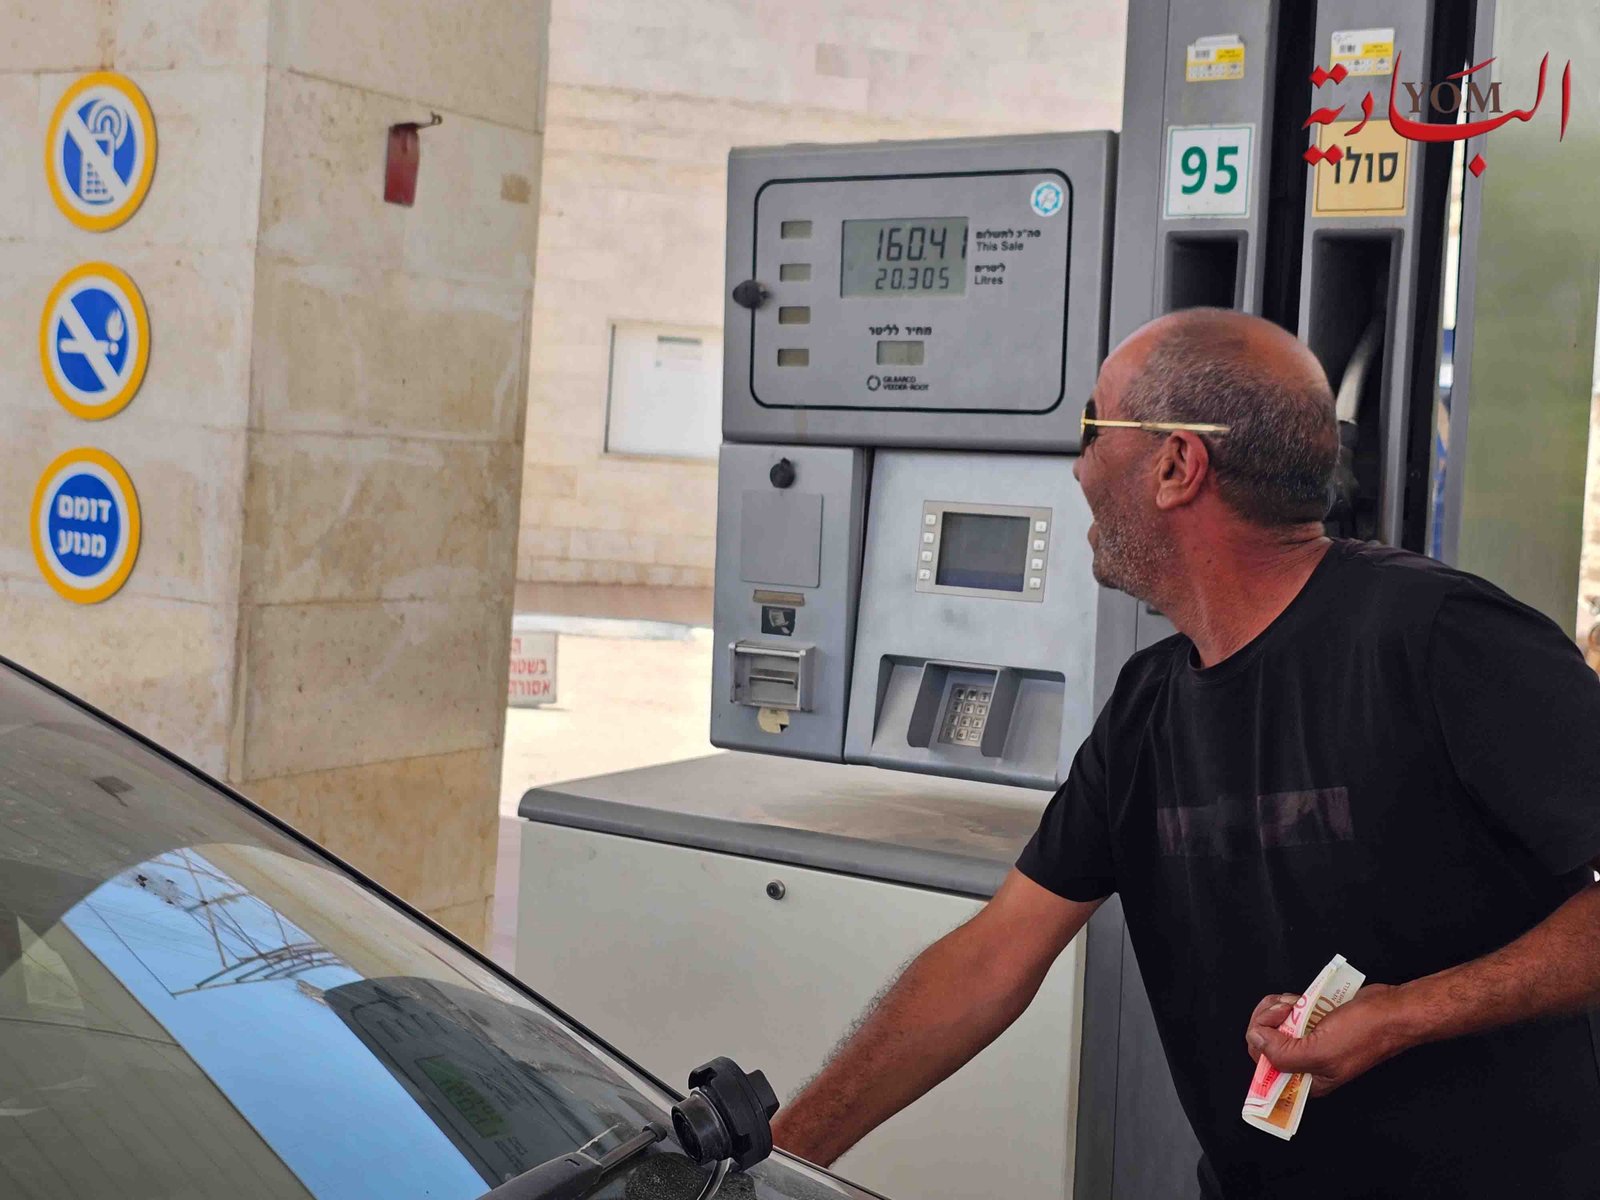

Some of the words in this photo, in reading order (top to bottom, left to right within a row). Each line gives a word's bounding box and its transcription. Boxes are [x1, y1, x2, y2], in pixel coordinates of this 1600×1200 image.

[1181, 146, 1238, 195] 95
[876, 227, 968, 261] 160.41
[976, 241, 998, 251] This
[1001, 241, 1024, 251] Sale
[875, 267, 949, 289] 20.305
[974, 275, 1003, 285] Litres
[868, 324, 899, 336] לליטר
[905, 326, 932, 336] מחיר
[57, 494, 112, 524] דומם
[57, 529, 107, 558] מנוע
